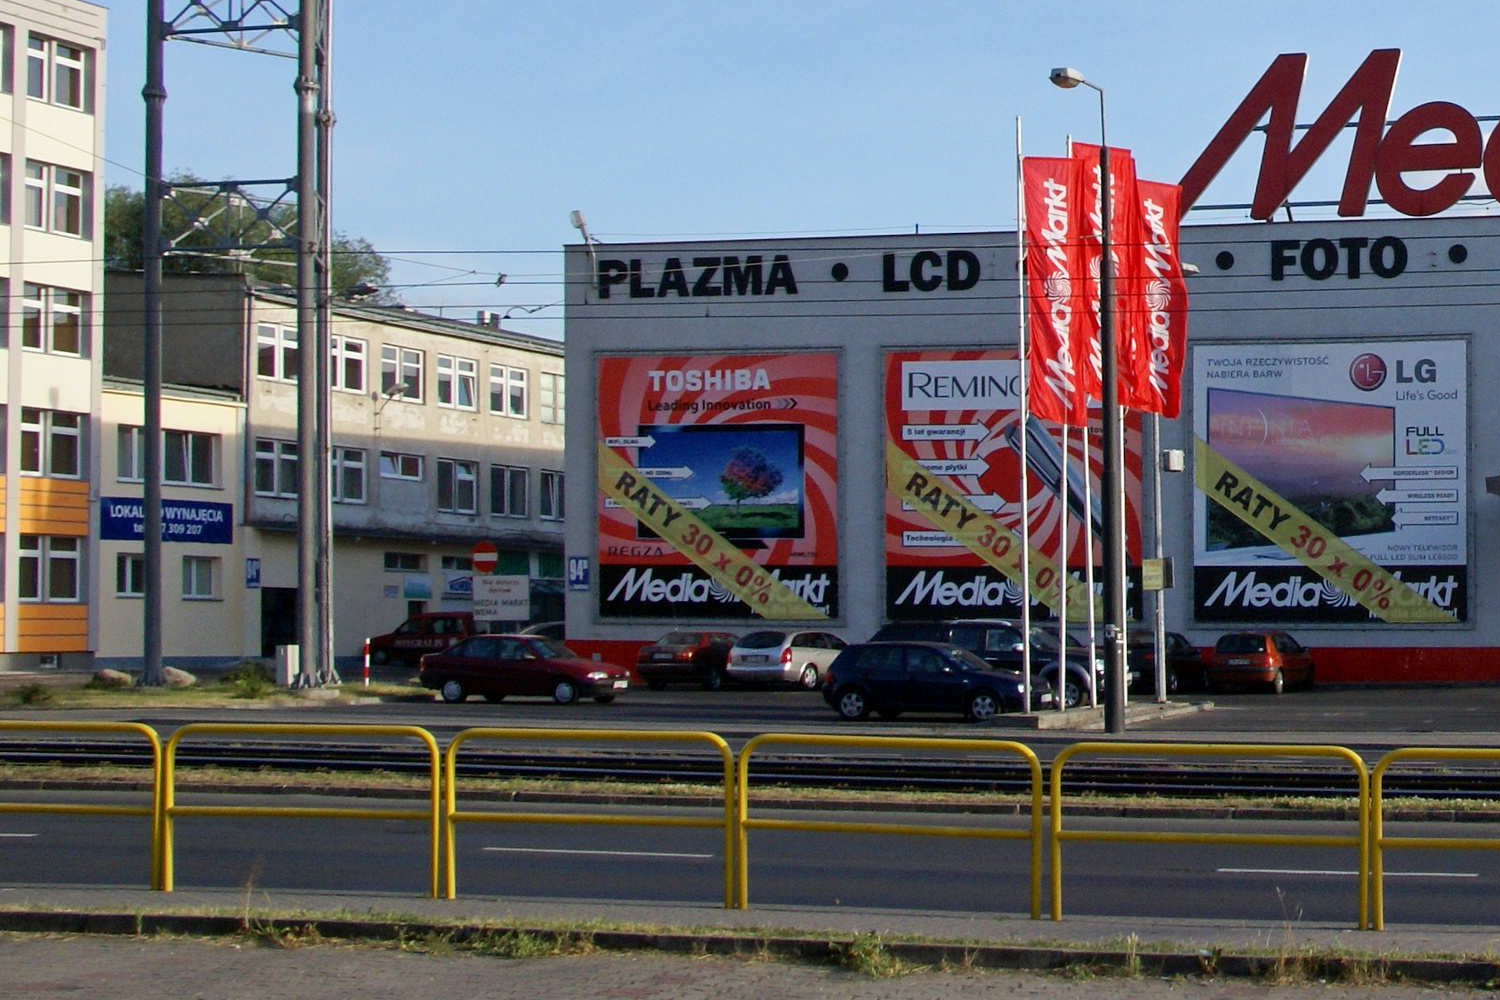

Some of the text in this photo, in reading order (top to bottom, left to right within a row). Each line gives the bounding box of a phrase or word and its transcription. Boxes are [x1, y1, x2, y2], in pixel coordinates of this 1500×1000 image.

[1041, 178, 1069, 279] Markt
[1144, 198, 1171, 288] Markt
[598, 255, 798, 299] PLAZMA
[883, 250, 981, 292] LCD
[1271, 236, 1408, 282] FOTO
[1207, 356, 1329, 367] TWOJA RZECZYWISTOŚĆ
[1207, 369, 1283, 379] NABIERA BARW
[1395, 359, 1437, 384] LG
[649, 369, 771, 392] TOSHIBA
[1395, 389, 1458, 401] Life's Good
[649, 399, 771, 413] Leading Innovation
[927, 428, 966, 438] gwarancji
[1406, 426, 1444, 437] FULL
[1406, 439, 1445, 455] LED
[166, 507, 223, 523] WYNAJĘCIA
[905, 472, 978, 530] RATY
[977, 524, 1011, 558] 30
[134, 523, 144, 533] te
[168, 523, 185, 534] 309
[186, 524, 202, 535] 207
[615, 471, 772, 605] RATY 30 x 0%
[1214, 470, 1395, 611] RATY 30 x 0%
[607, 545, 664, 558] REGZA
[1387, 543, 1458, 552] NOWY TELEWIZOR
[607, 568, 830, 603] Media arkt
[895, 571, 1008, 606] Media
[1204, 571, 1321, 608] Media
[1388, 571, 1458, 607] arkt
[474, 599, 498, 607] MEDIA
